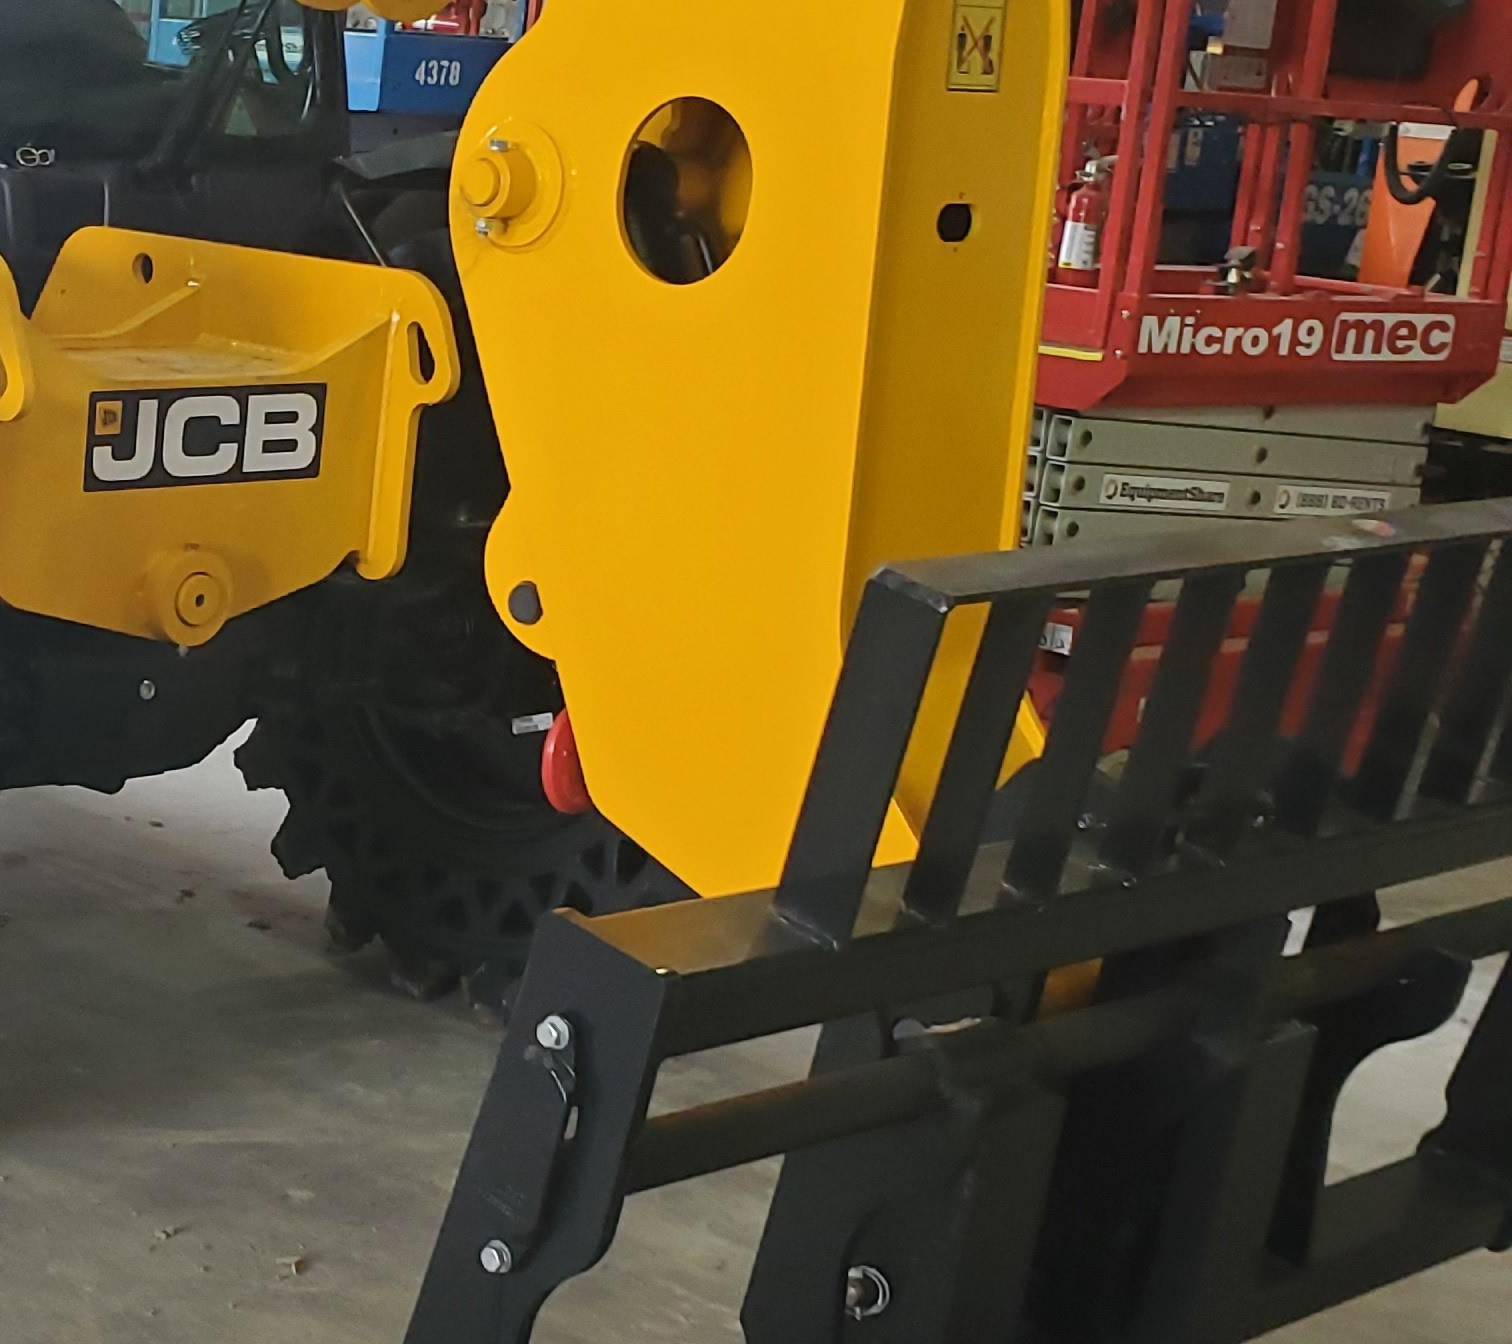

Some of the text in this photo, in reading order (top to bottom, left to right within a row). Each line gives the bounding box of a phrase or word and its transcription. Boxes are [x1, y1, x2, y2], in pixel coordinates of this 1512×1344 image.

[414, 59, 461, 86] 4378
[1138, 314, 1452, 356] Micro19 mec
[92, 393, 318, 482] JCB
